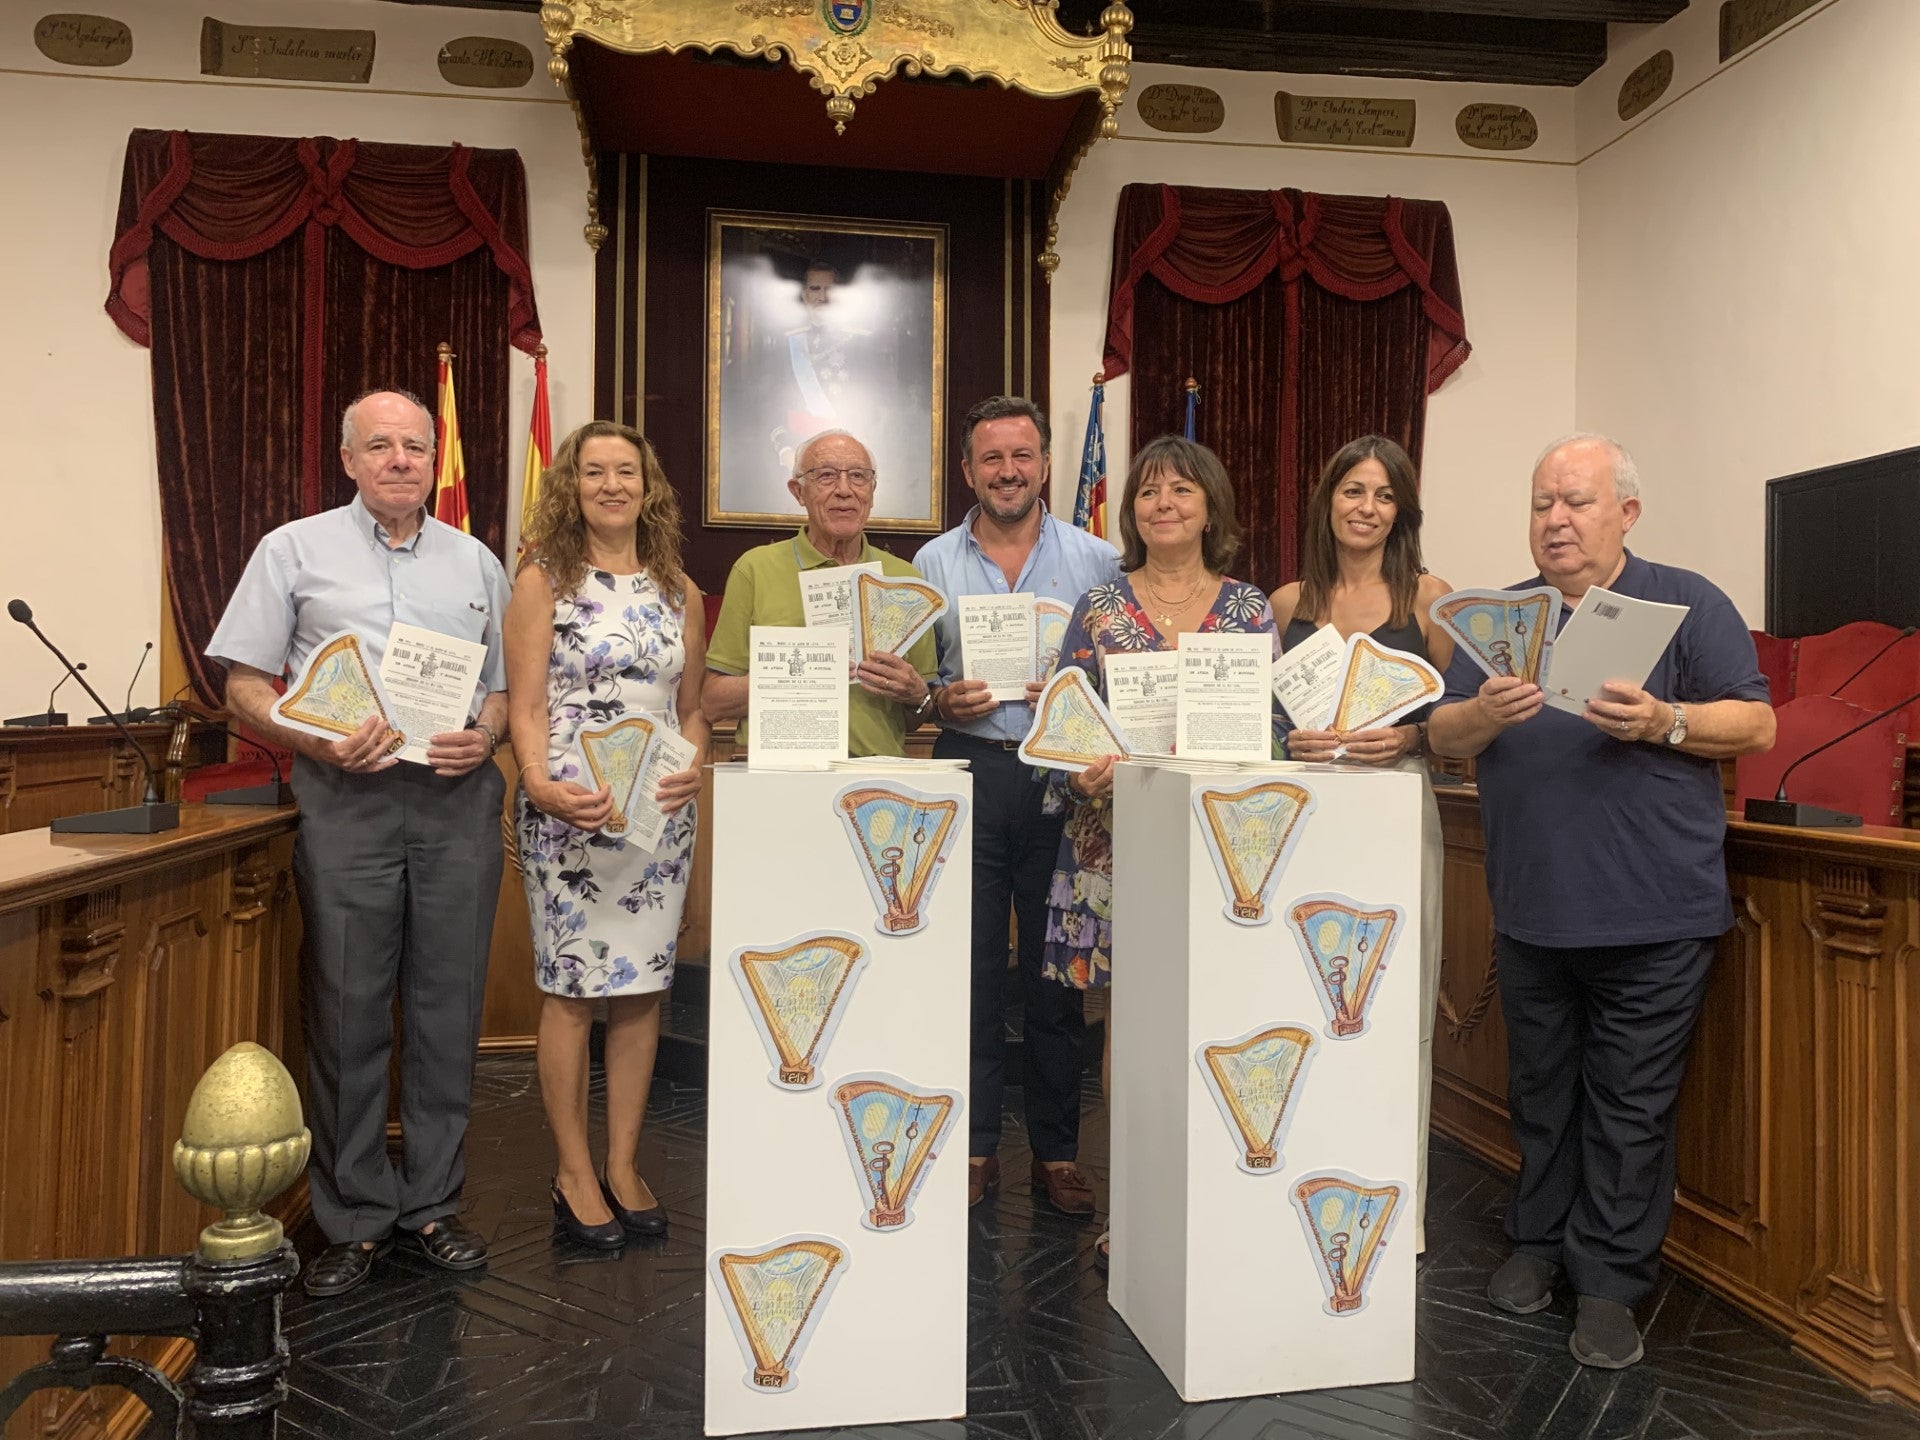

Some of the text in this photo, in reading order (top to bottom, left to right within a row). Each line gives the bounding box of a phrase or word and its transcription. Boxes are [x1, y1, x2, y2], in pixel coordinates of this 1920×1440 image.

[263, 36, 320, 58] Indalecio
[413, 652, 422, 662] DE
[758, 652, 775, 662] DIARIO
[779, 652, 786, 662] DE
[1185, 658, 1202, 667] DIARIO
[1205, 658, 1212, 667] DE
[1132, 676, 1139, 685] DE
[781, 1072, 806, 1084] d'Elx
[755, 1375, 781, 1388] d'Elx
